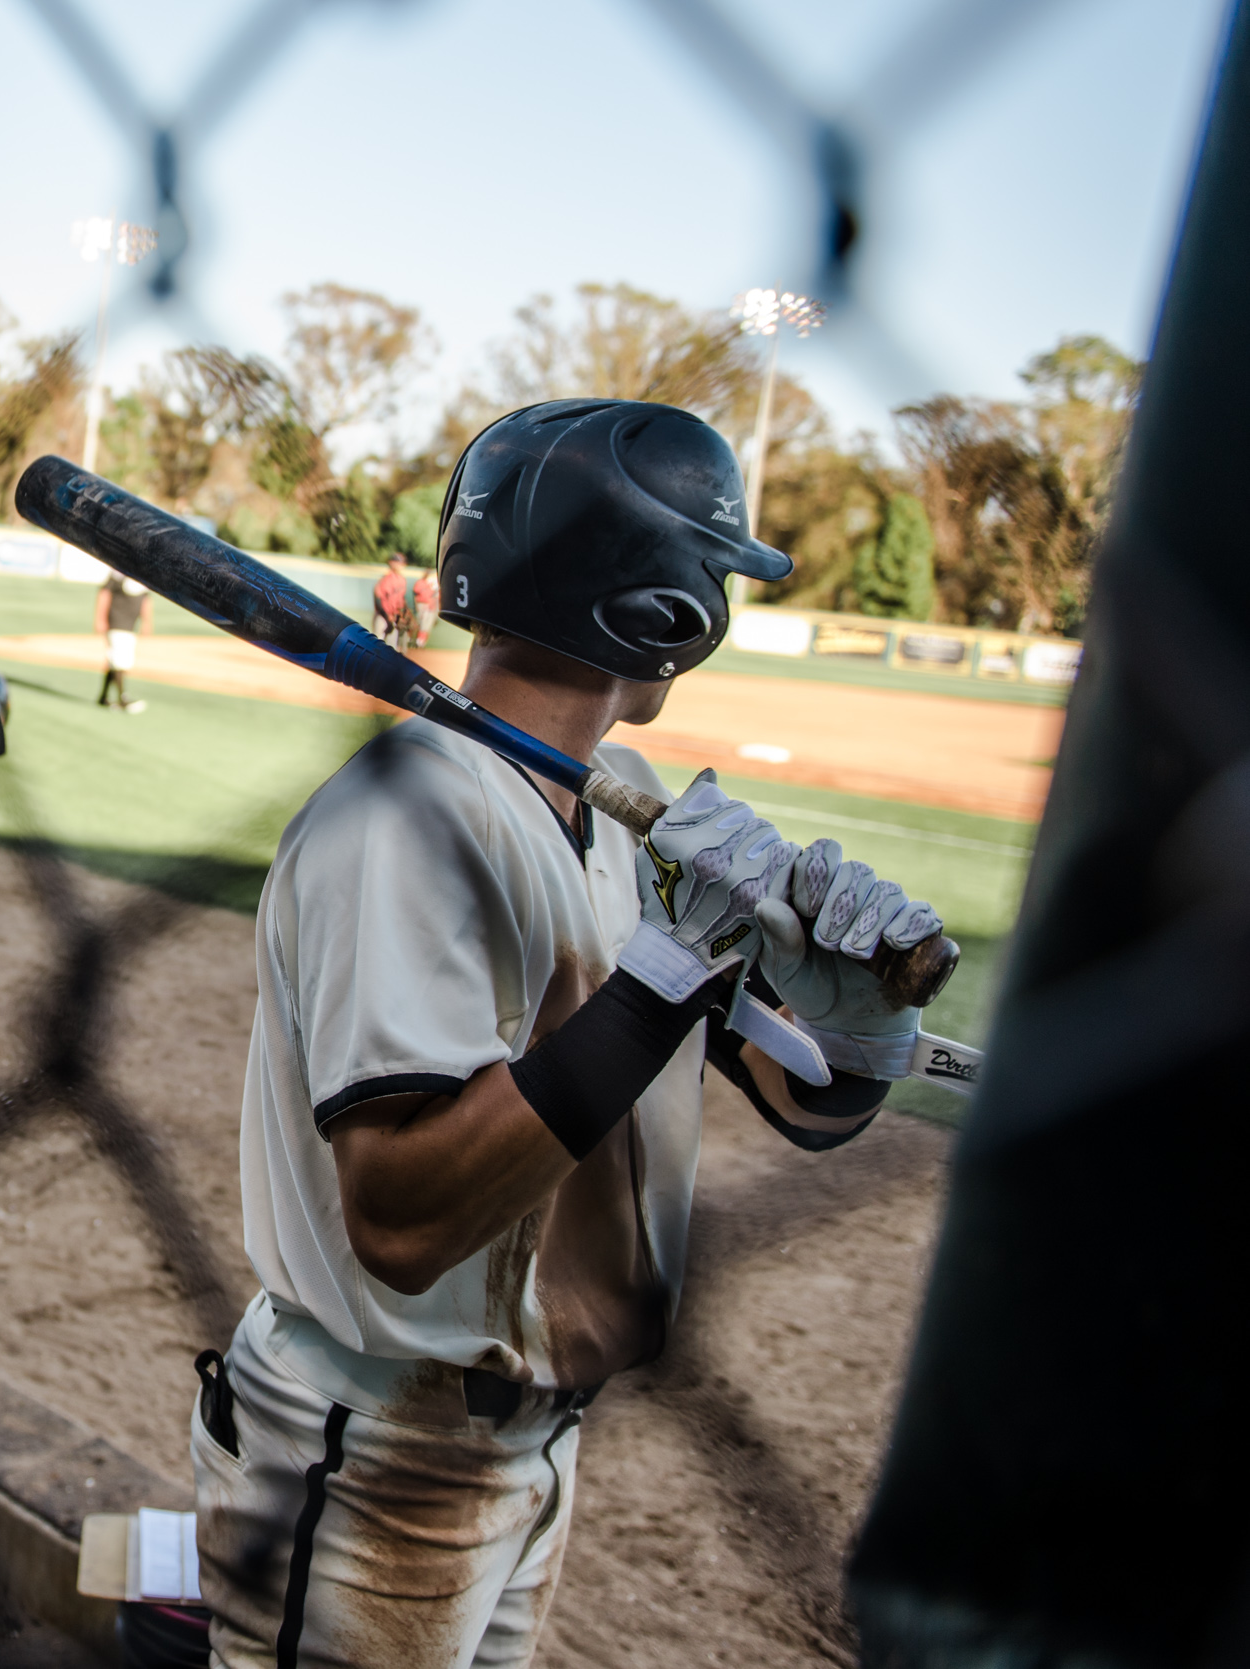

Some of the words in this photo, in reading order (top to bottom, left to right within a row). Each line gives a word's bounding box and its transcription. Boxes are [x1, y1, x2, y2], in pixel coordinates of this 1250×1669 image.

[454, 505, 483, 520] MIZUNO
[710, 509, 740, 526] MIZUNO
[456, 574, 469, 608] 3
[713, 925, 749, 956] MIZUNO
[930, 1048, 981, 1077] Dirtb
